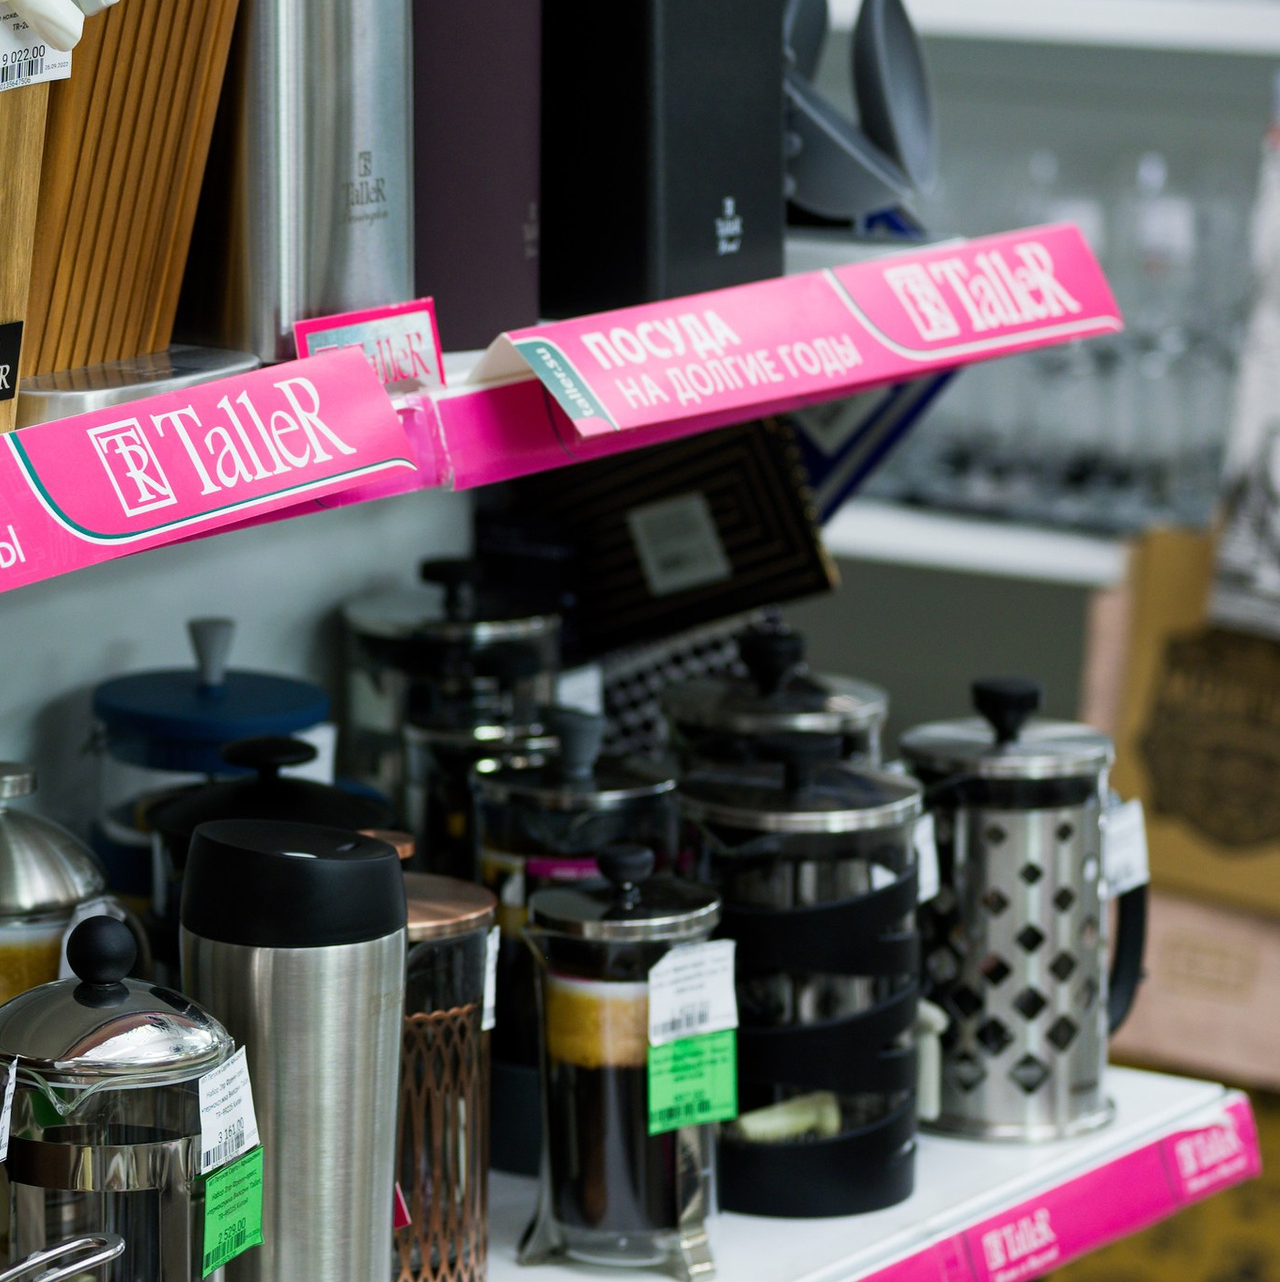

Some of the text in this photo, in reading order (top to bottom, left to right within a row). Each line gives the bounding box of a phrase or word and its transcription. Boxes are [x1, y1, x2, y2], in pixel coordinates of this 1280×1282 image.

[2, 45, 46, 65] 9 022.00
[343, 178, 386, 206] TalleR
[931, 240, 1083, 335] TalleR
[581, 309, 741, 370] ПОСУДА
[535, 346, 599, 418] taller.su
[617, 334, 865, 410] НА ДОЛГИЕ ГОДЫ
[150, 377, 357, 496] TalleR
[224, 1117, 245, 1141] 161.00
[224, 1217, 246, 1241] 529.00
